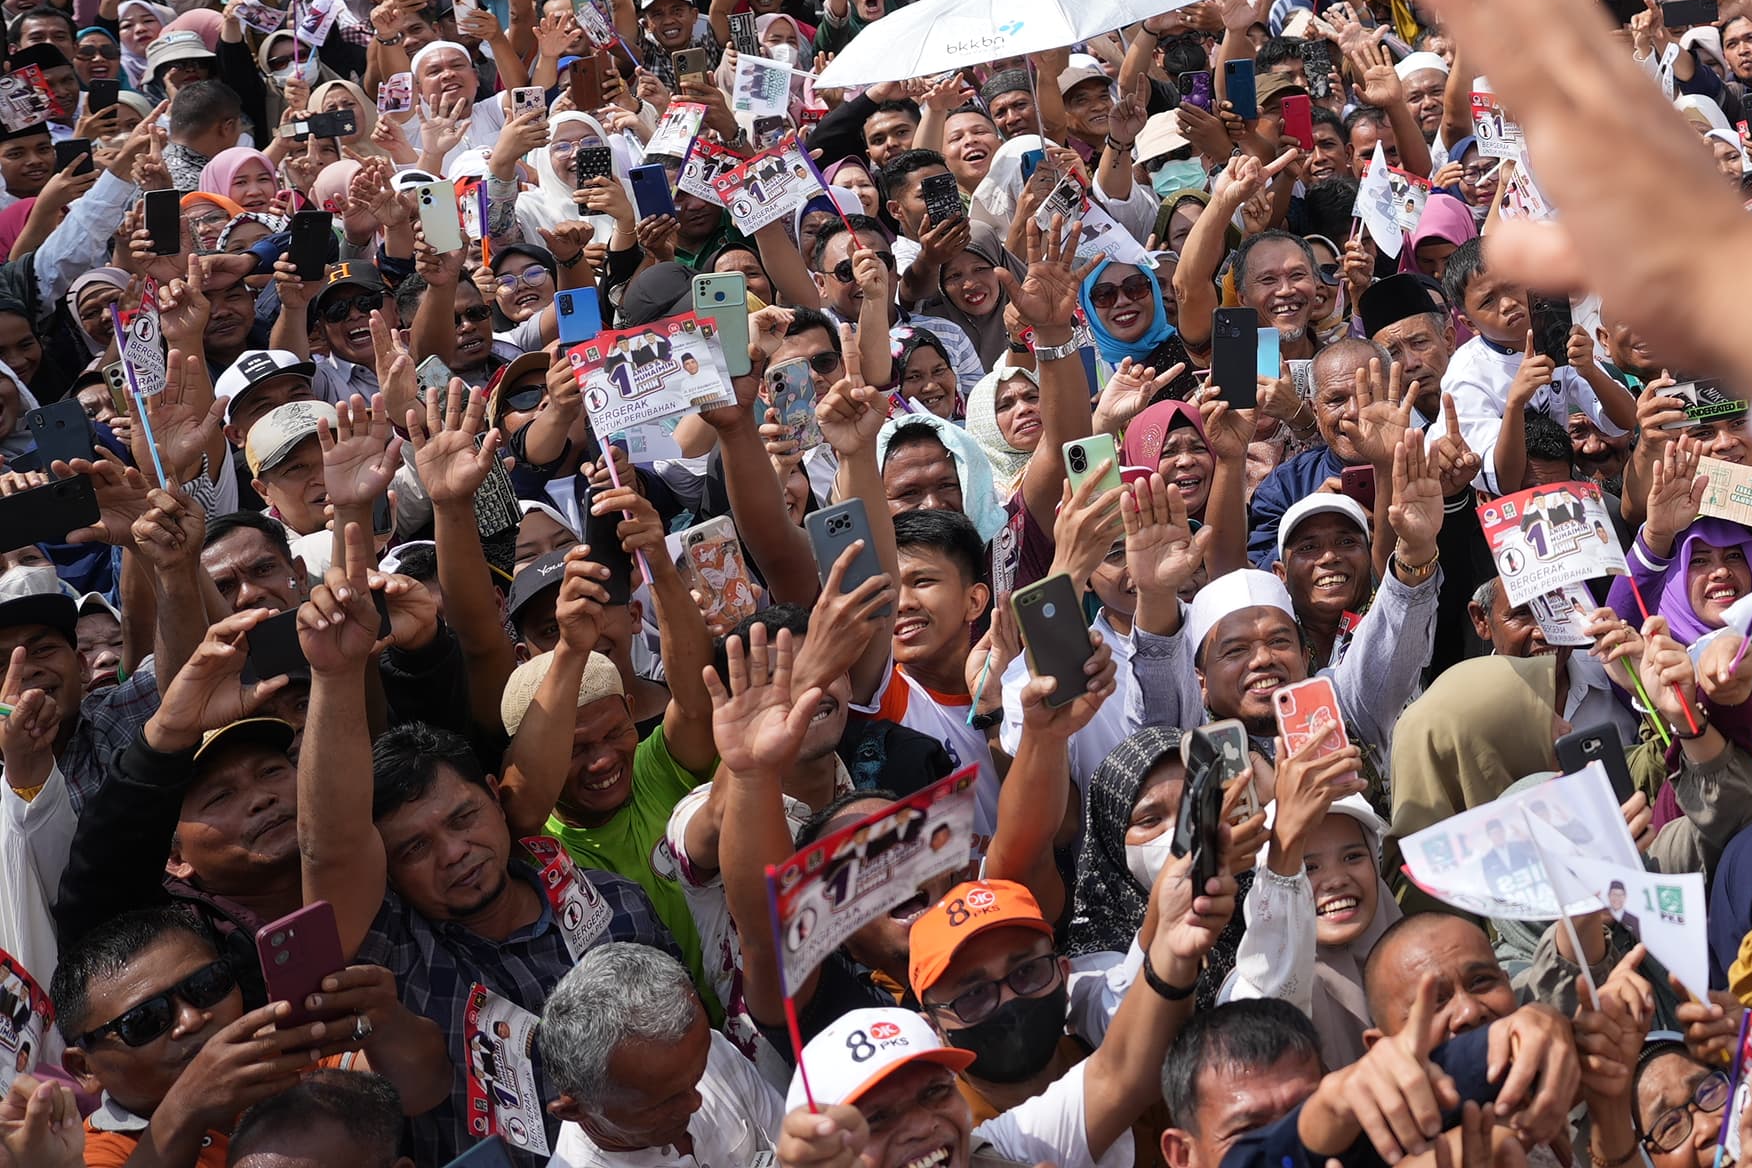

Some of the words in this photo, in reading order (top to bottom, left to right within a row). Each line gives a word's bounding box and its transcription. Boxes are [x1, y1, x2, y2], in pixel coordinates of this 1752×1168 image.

[946, 36, 1005, 54] bkkbn
[1493, 115, 1503, 137] 1
[750, 181, 767, 203] 1
[743, 203, 780, 227] BERGERAK
[610, 363, 632, 396] 1
[634, 360, 675, 382] MUHAIMIN
[638, 379, 660, 394] AMIN
[593, 400, 649, 427] BERGERAK
[624, 401, 677, 424] PERUBAHAN
[1527, 523, 1548, 558] 1
[1549, 524, 1571, 536] ANIES
[1550, 525, 1589, 544] MUHAIMIN
[1510, 561, 1567, 592] BERGERAK
[1512, 586, 1539, 602] UNTUK
[1541, 567, 1593, 592] PERUBAHAN
[946, 898, 971, 927] 8
[1643, 888, 1655, 913] 1
[846, 1030, 876, 1063] 8
[880, 1037, 910, 1051] PKS
[522, 1091, 540, 1149] BERGERAK
